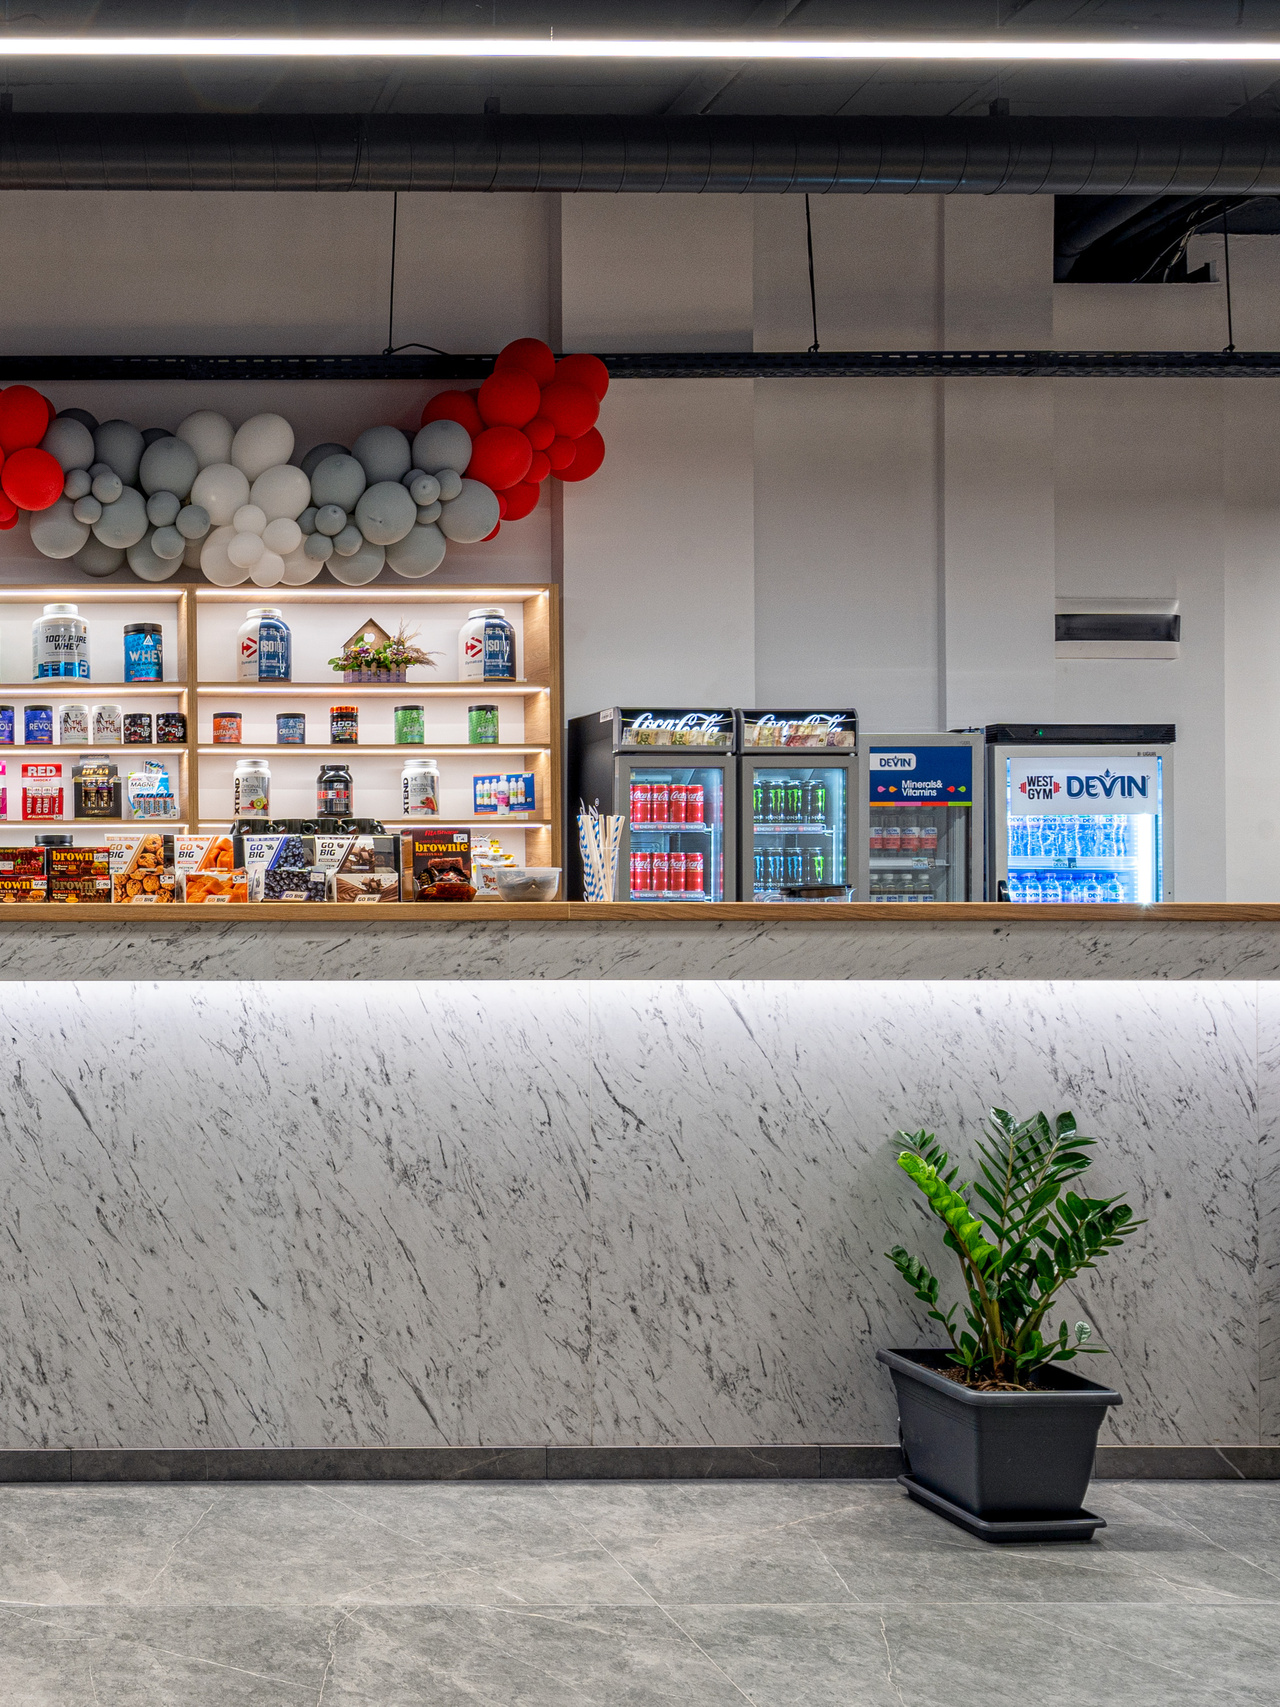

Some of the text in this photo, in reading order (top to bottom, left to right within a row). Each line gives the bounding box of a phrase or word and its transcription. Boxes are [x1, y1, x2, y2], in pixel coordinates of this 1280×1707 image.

[45, 635, 87, 644] 100% PURE
[54, 643, 80, 651] WHEY
[129, 650, 163, 663] WHEY
[880, 756, 912, 768] DEVIN
[27, 766, 57, 777] RED
[1027, 775, 1054, 787] WEST
[1066, 769, 1149, 799] DEVIN
[902, 788, 937, 796] Vitamins
[1027, 788, 1053, 800] GYM
[415, 842, 468, 852] brownie
